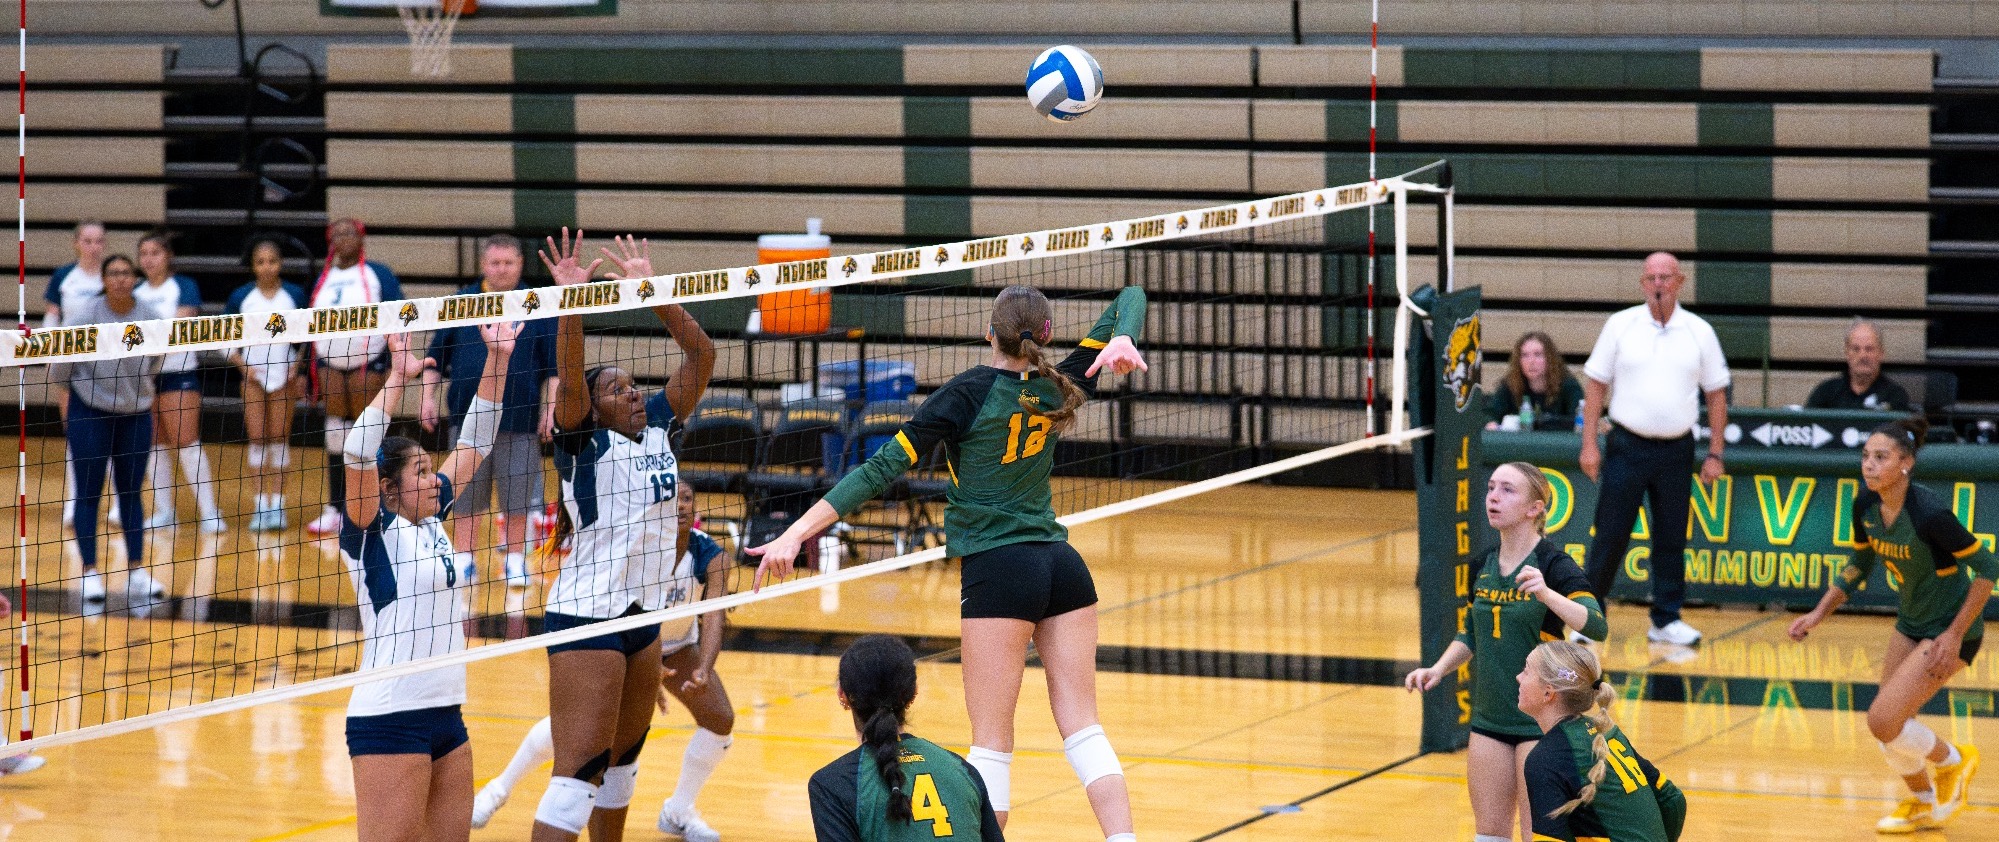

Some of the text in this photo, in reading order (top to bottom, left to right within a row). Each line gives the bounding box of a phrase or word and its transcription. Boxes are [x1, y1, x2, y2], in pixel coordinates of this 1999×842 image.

[168, 315, 243, 346] JAGUARS
[308, 305, 379, 334] JAGUARS
[438, 295, 504, 322] JAGUARS
[559, 283, 620, 310] JAGUARS
[672, 271, 728, 297] JAGUARS
[776, 260, 827, 284] JAGUARS
[1001, 412, 1052, 465] 12
[1771, 425, 1812, 445] POSS
[650, 472, 676, 504] 19
[1624, 546, 1867, 591] CMMUNIT
[1492, 605, 1502, 639] 1
[1605, 738, 1648, 794] 16
[911, 773, 953, 838] 4
